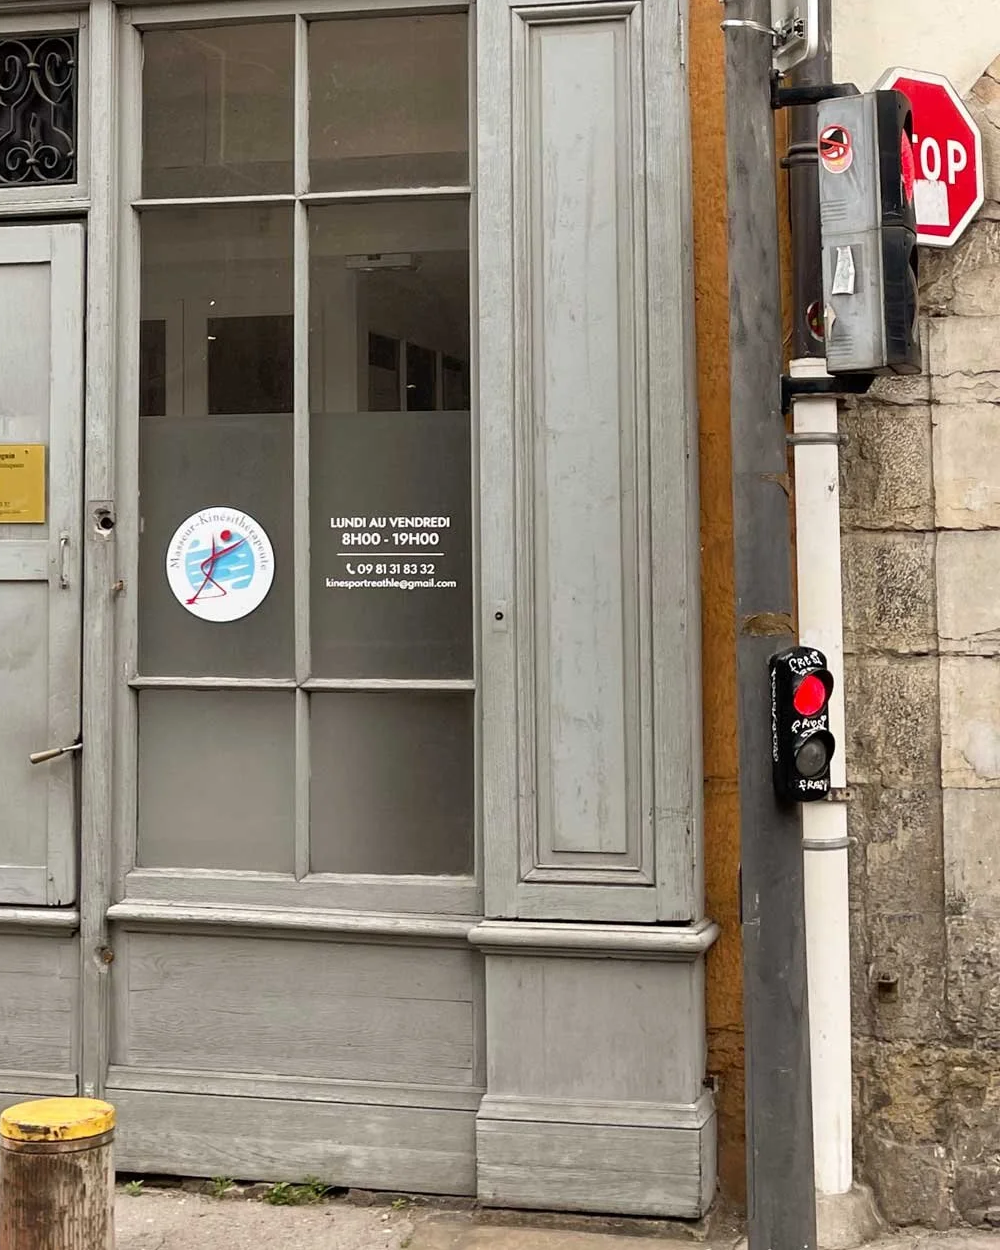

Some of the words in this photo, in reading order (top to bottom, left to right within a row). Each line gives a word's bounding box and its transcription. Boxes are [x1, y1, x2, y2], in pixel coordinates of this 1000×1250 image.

[912, 134, 967, 184] OP
[330, 517, 366, 528] LUNDI
[369, 517, 386, 528] AU
[389, 516, 450, 528] VENDREDI
[341, 532, 381, 546] 8H00
[392, 532, 440, 546] 19H00
[357, 563, 373, 575] 09
[375, 563, 387, 575] 81
[389, 563, 400, 575] 31
[403, 563, 418, 575] 83
[420, 563, 435, 575] 32
